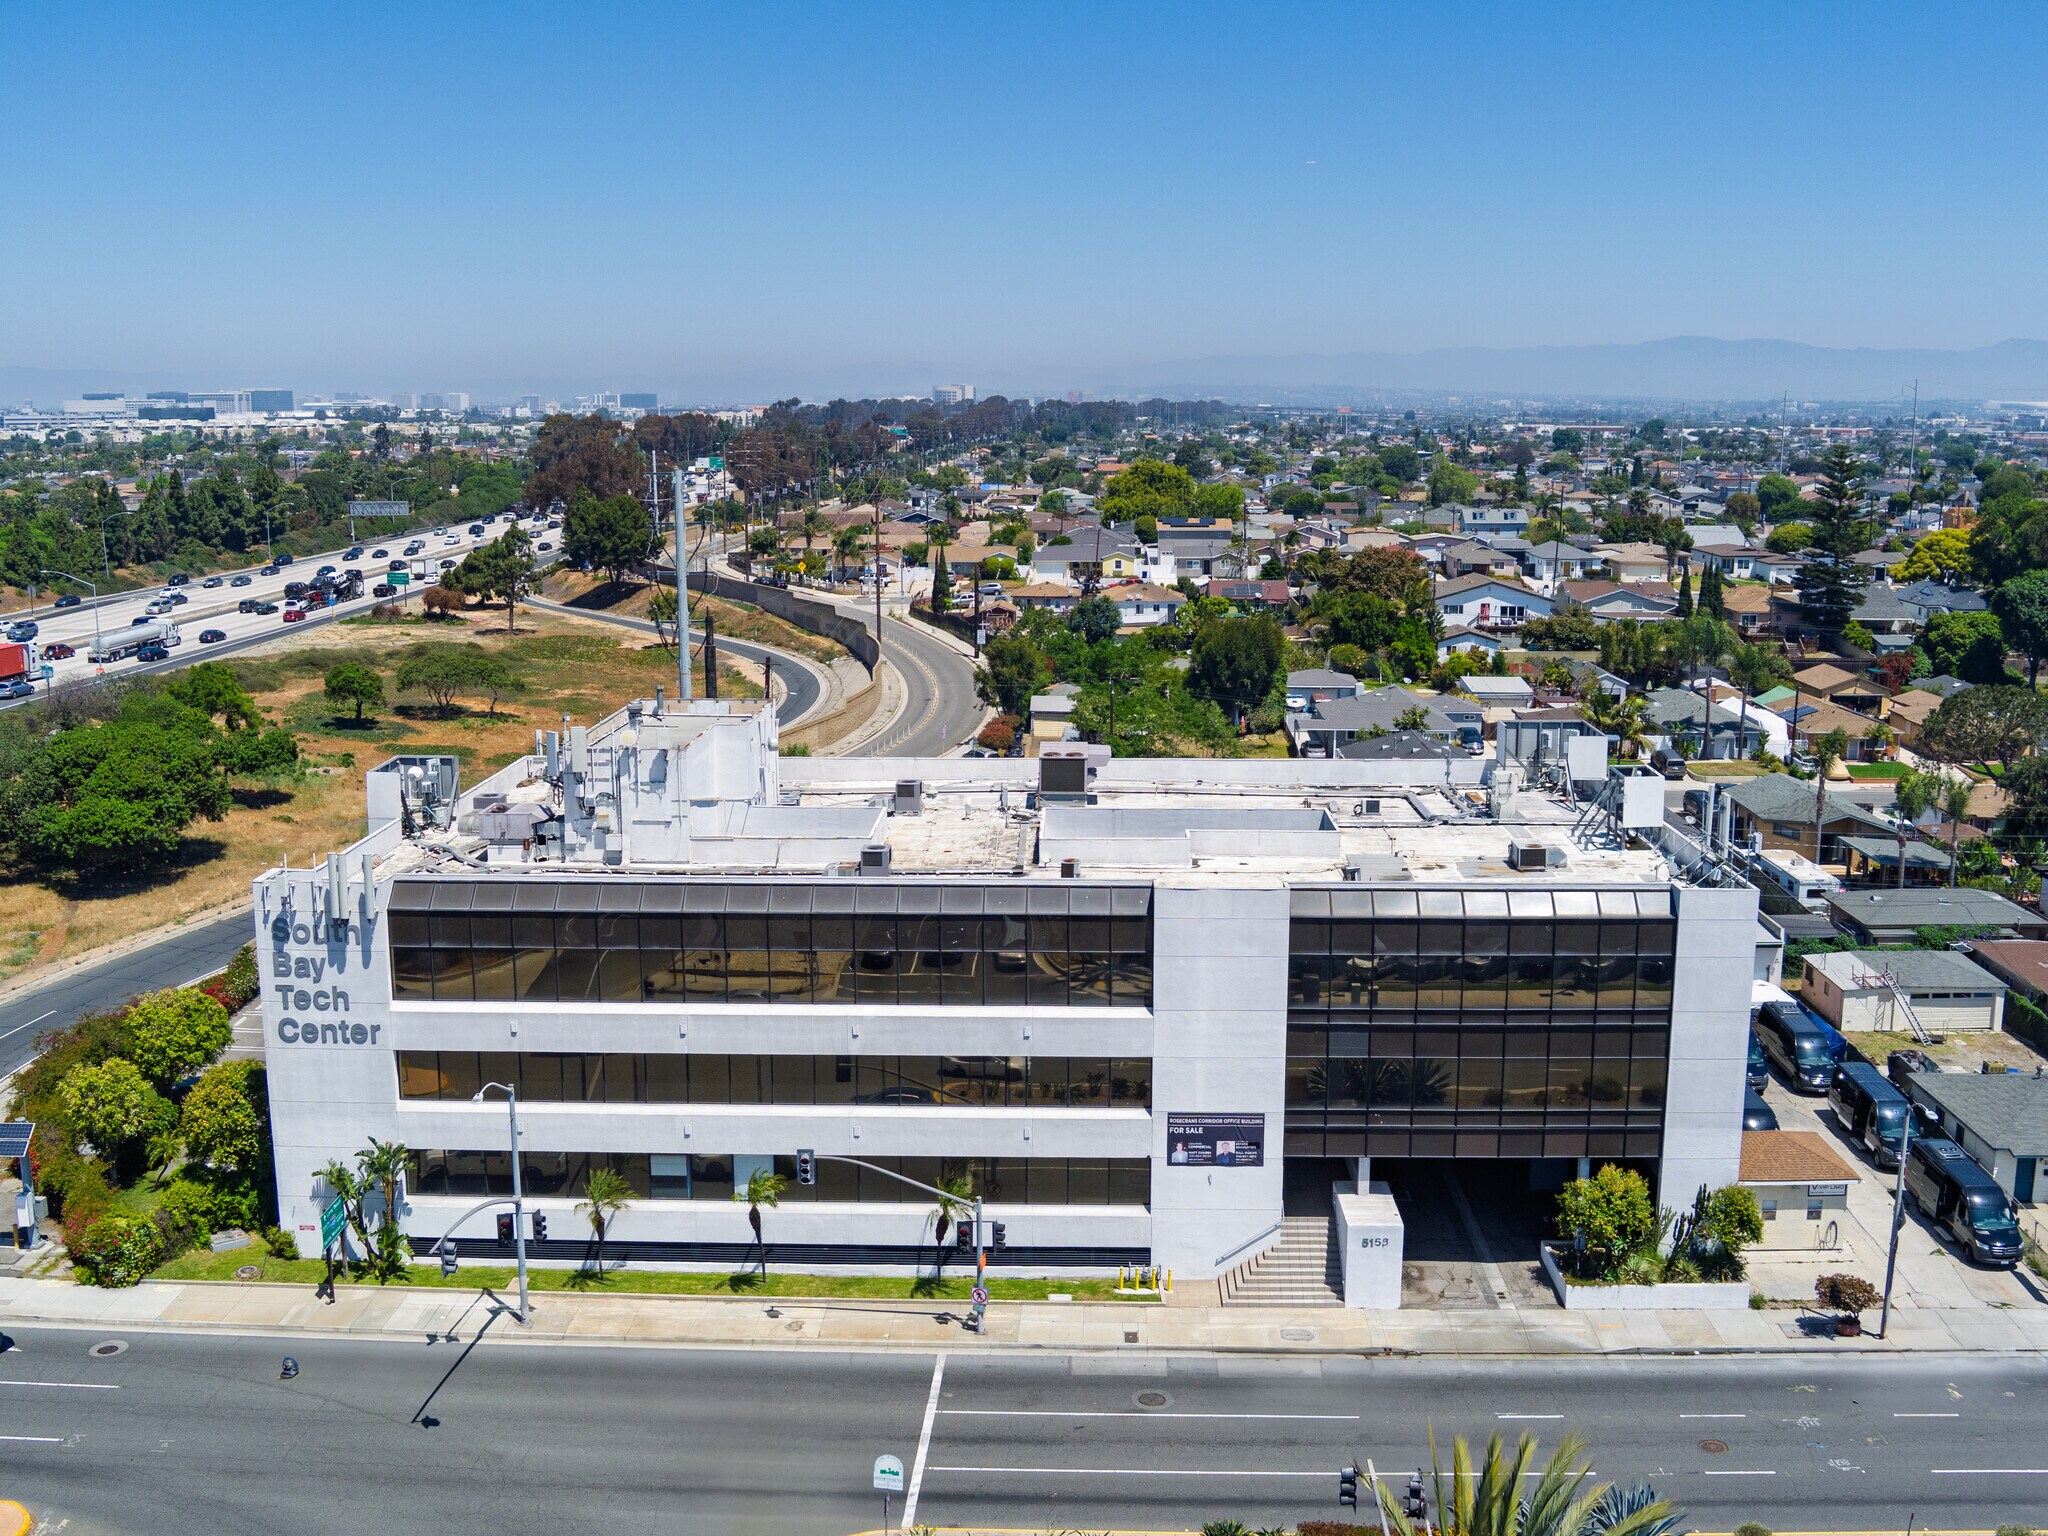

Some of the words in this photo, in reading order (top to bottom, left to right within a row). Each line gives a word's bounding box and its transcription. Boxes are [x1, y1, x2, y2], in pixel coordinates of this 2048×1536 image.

[271, 917, 361, 946] South
[272, 951, 327, 984] Bay
[275, 984, 350, 1012] Tech
[278, 1017, 381, 1045] Center
